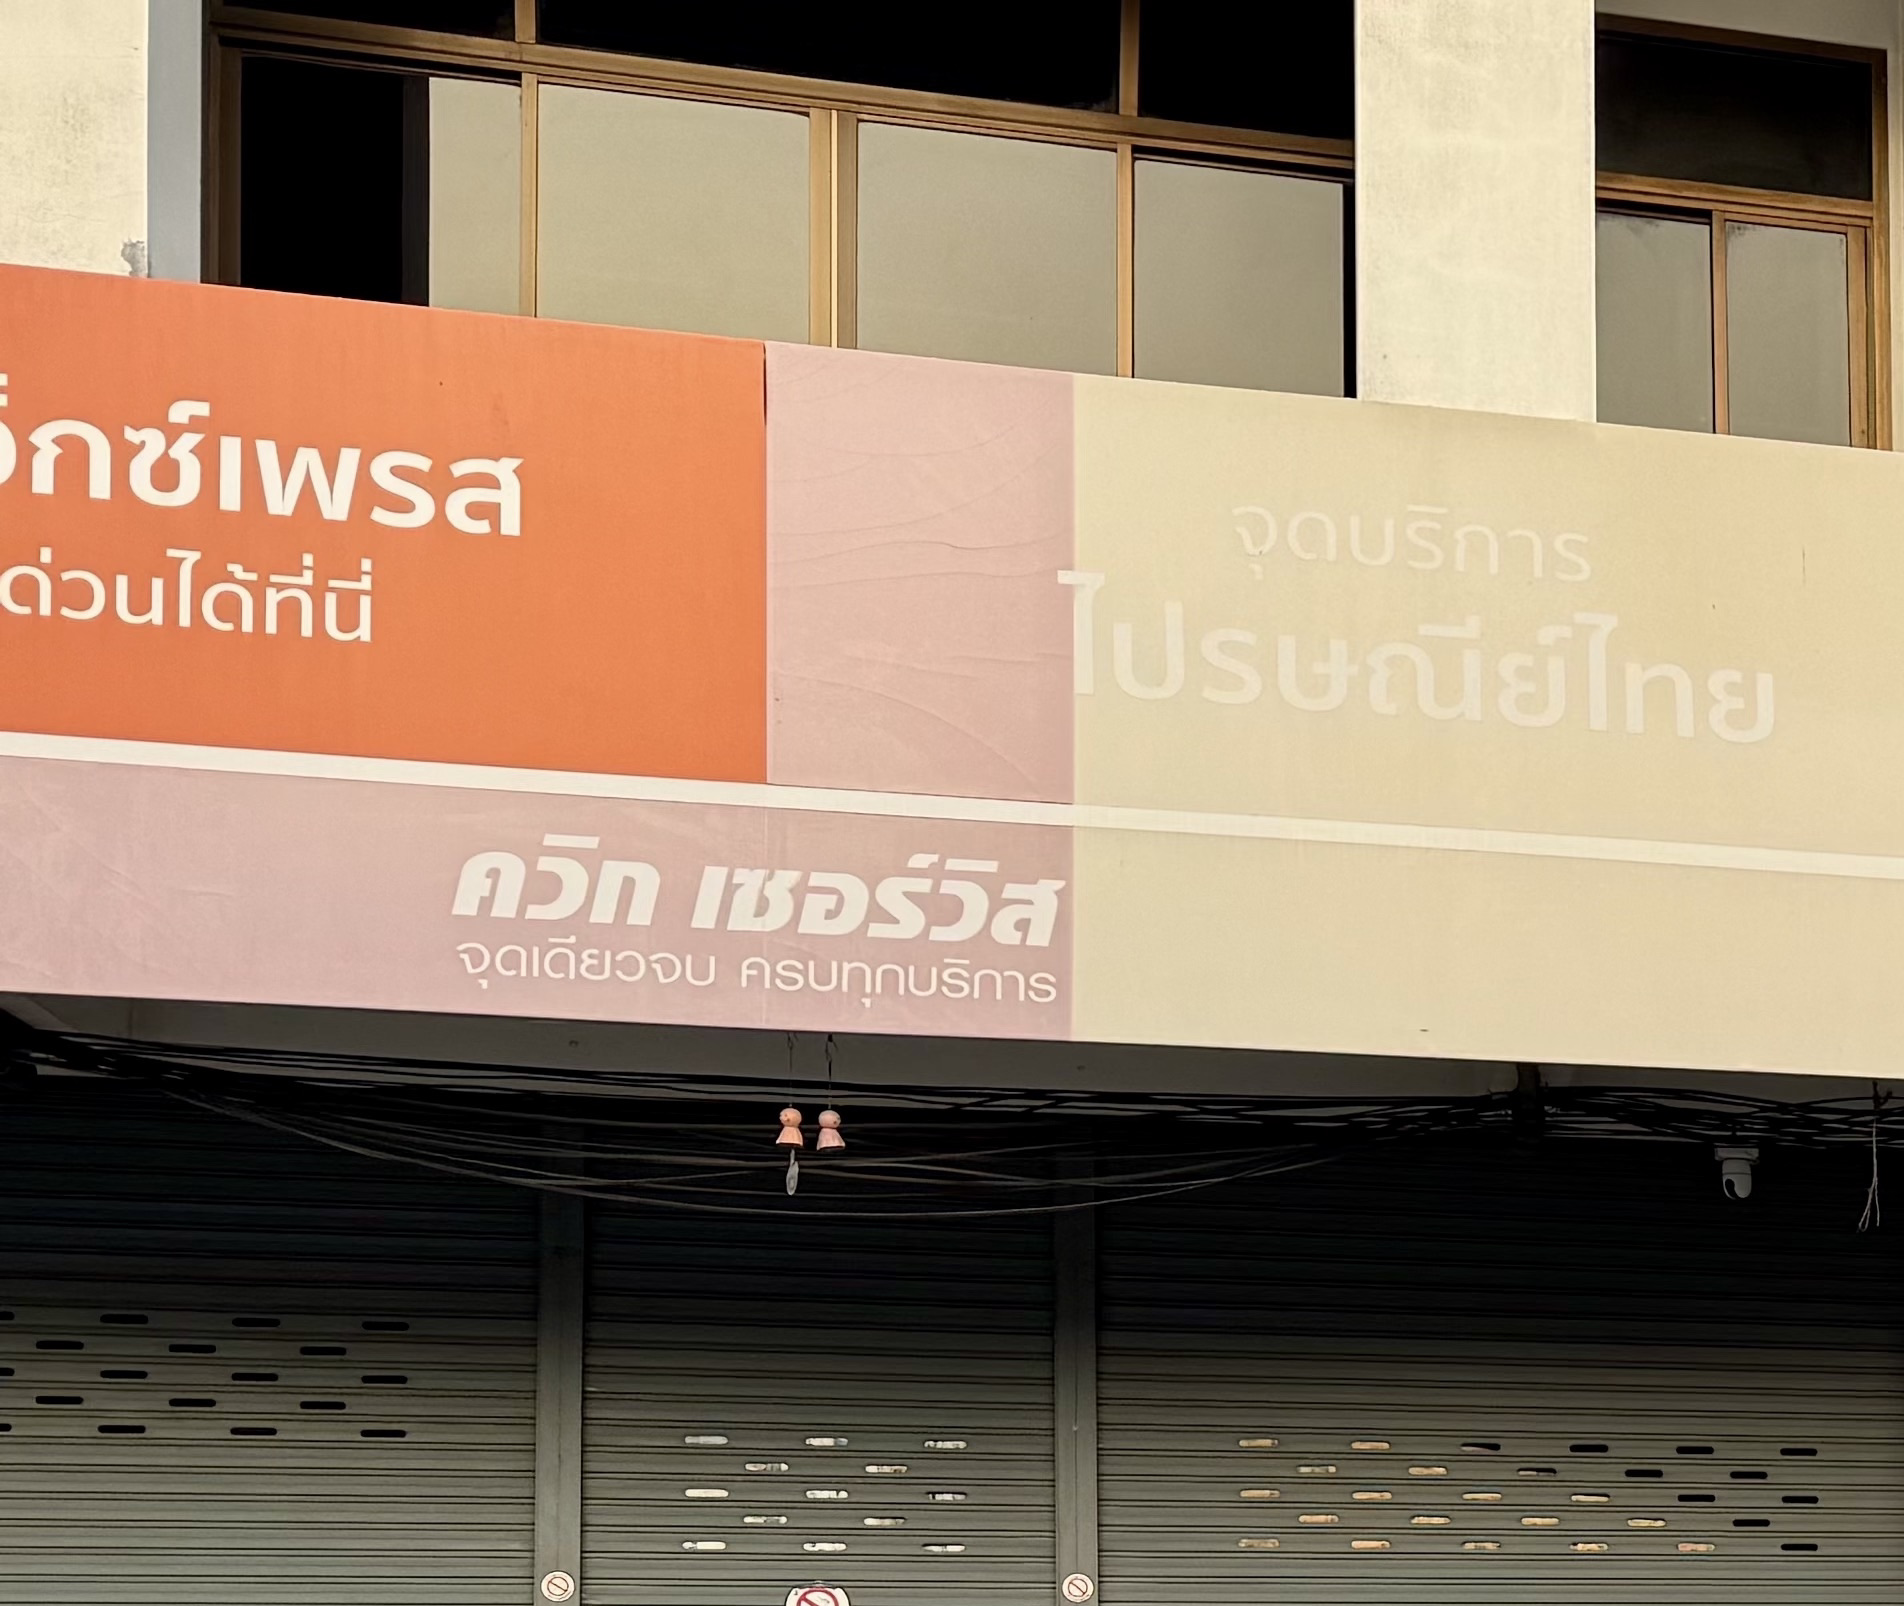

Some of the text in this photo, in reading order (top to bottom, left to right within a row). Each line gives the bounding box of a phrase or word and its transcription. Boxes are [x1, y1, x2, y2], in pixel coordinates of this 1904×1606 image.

[1231, 503, 1593, 583] จุดบริการ
[0, 546, 373, 642] ด่วนได้ที่นี่
[1056, 570, 1776, 744] ไปรษณีย์ไทย
[452, 834, 1066, 947] ควิก เซอร์วิส
[456, 936, 1058, 1008] จุดเดียวจบ ครบทุกบริการ
